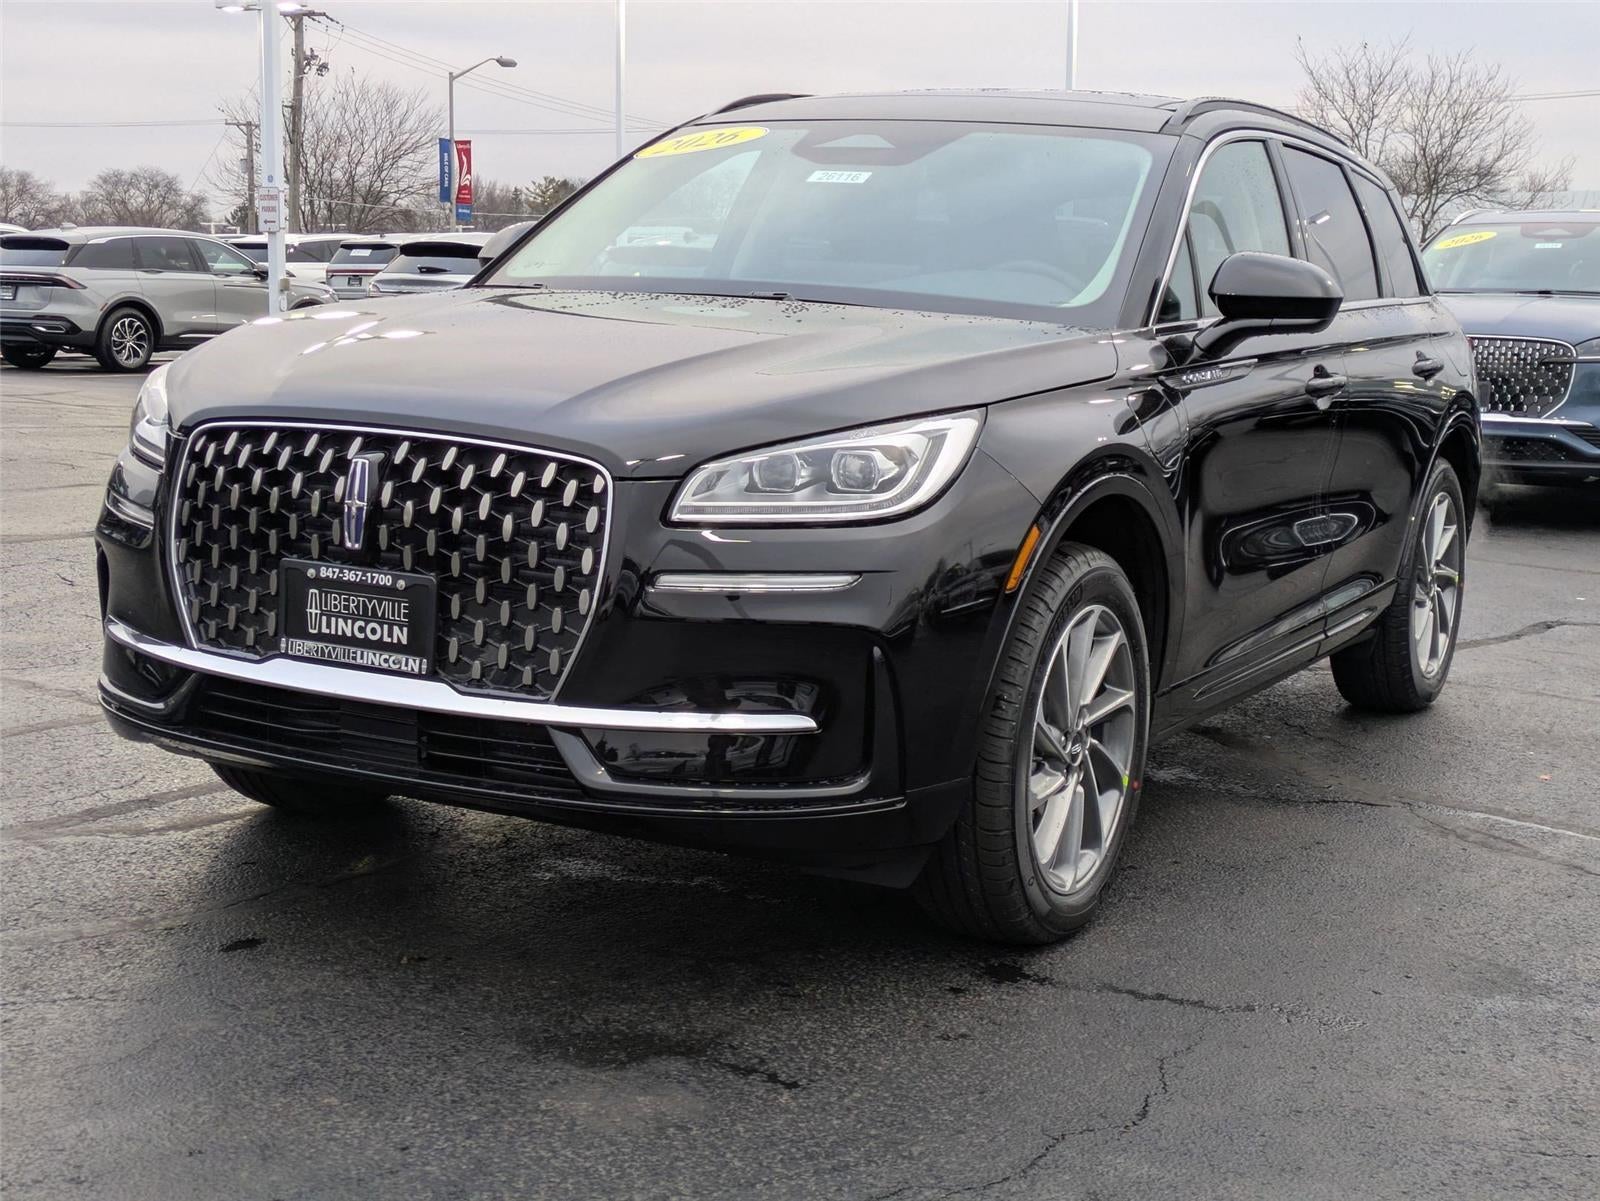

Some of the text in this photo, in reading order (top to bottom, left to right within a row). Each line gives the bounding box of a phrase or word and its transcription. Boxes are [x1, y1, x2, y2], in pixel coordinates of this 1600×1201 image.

[652, 131, 745, 154] 2026
[816, 172, 862, 182] 26116
[320, 566, 392, 586] 847-367-1700
[321, 592, 409, 621] LIBERTYVILLE
[321, 616, 408, 645] LINCOLN
